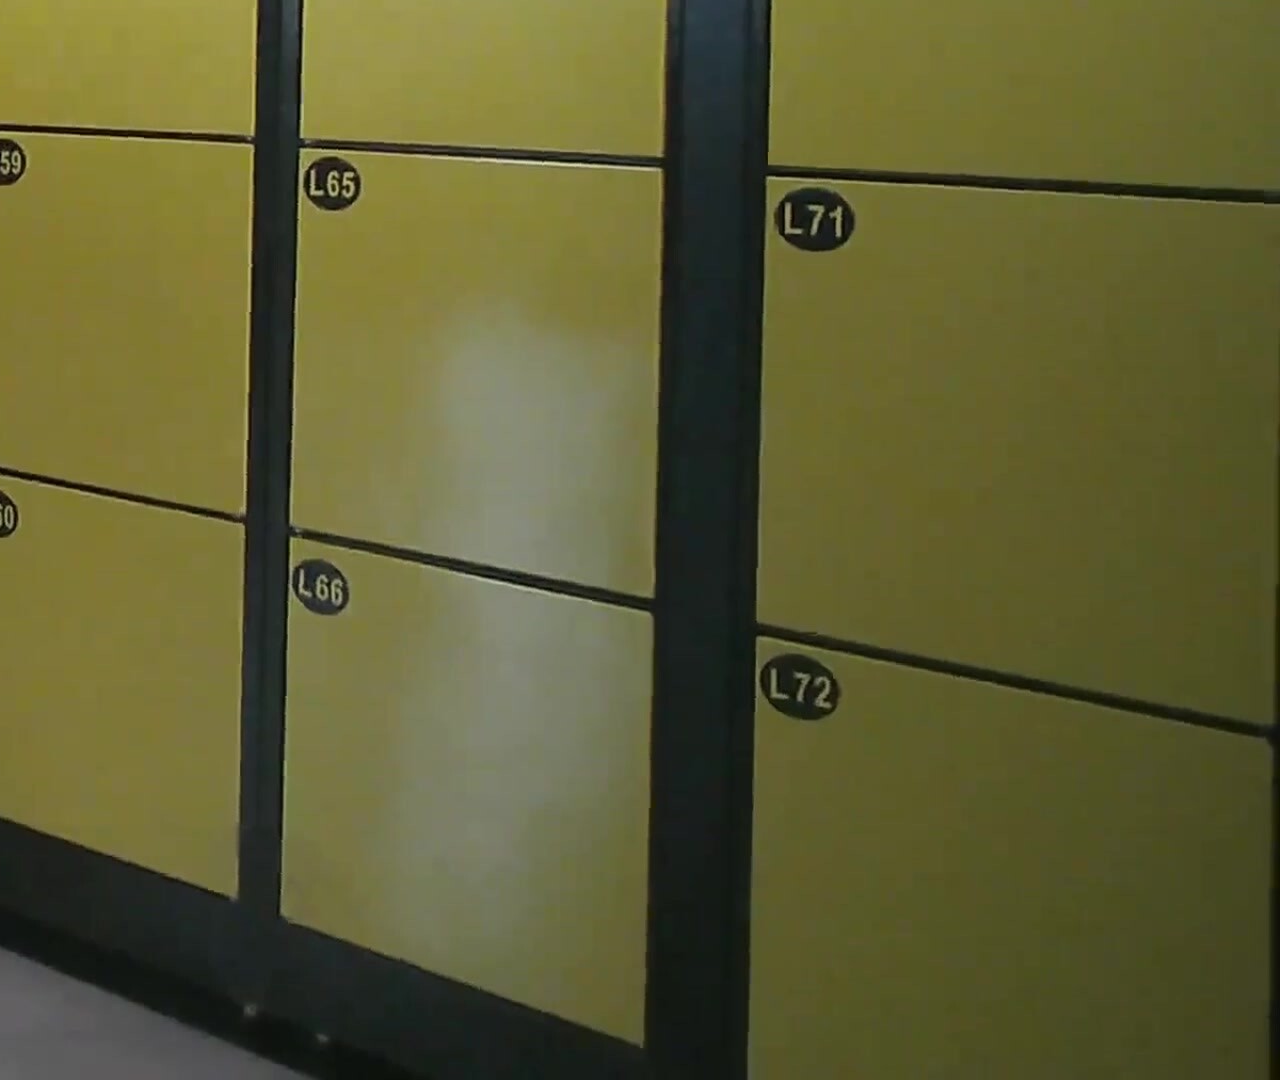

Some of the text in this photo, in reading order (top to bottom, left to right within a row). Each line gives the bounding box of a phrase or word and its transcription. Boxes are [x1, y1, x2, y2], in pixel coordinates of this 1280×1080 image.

[309, 170, 355, 199] L65
[784, 201, 844, 239] L71
[297, 569, 344, 607] L66
[770, 667, 833, 710] L72
